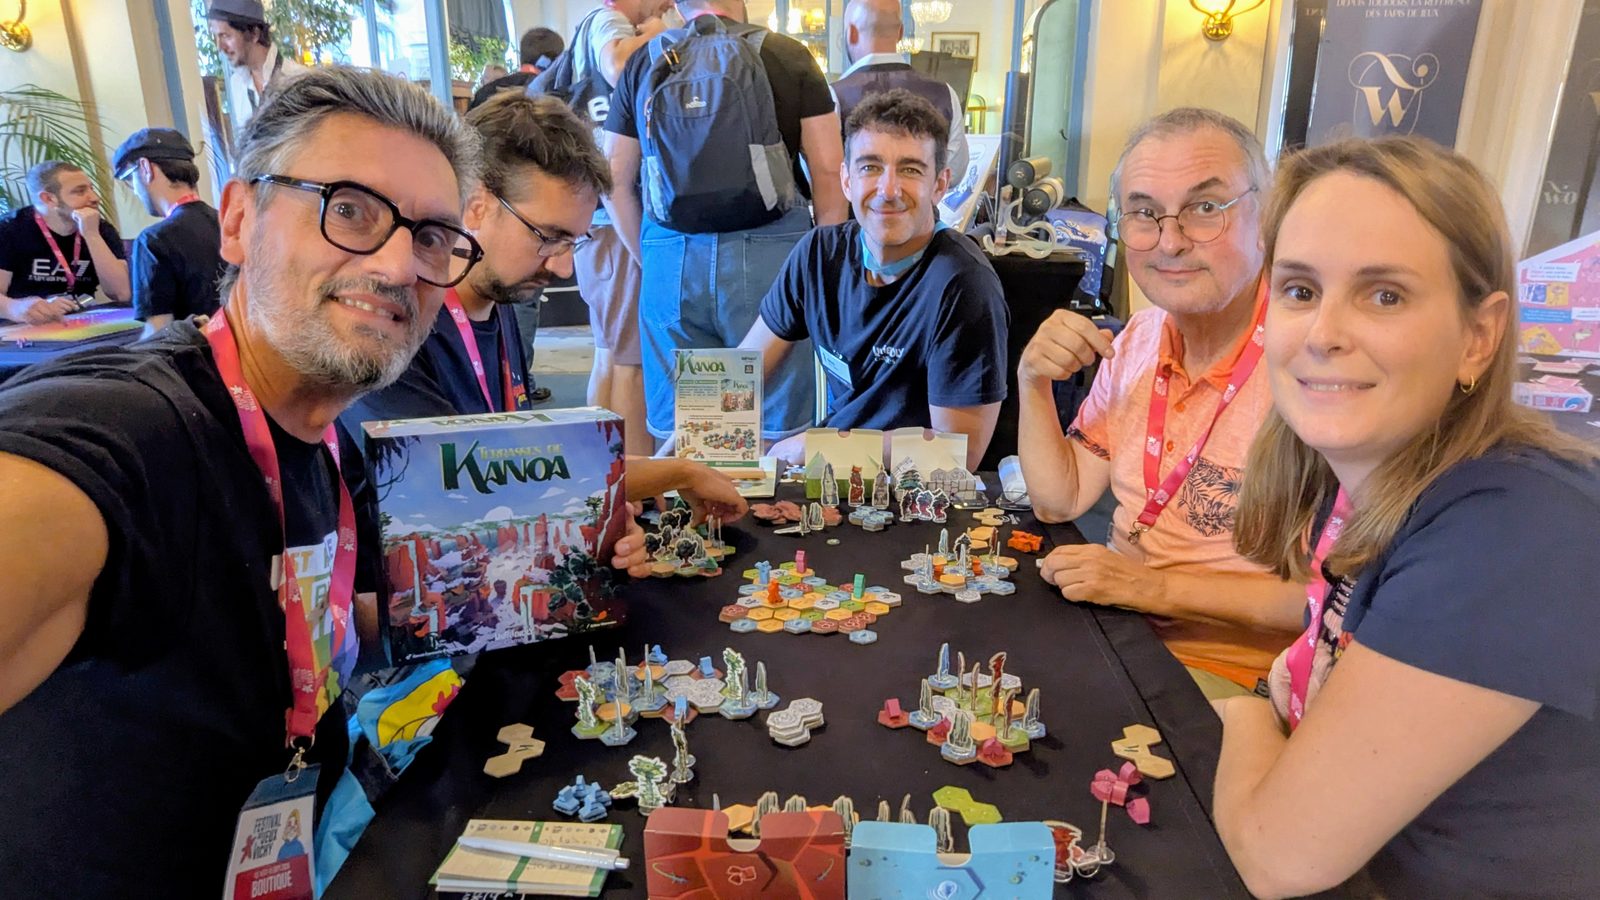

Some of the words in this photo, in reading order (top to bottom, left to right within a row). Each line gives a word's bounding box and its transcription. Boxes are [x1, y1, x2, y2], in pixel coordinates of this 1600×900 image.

[1365, 9, 1380, 17] DES
[1384, 9, 1404, 17] TAPIS
[1407, 9, 1419, 17] DE
[1420, 9, 1439, 17] JEUX
[678, 351, 726, 375] KANOA
[440, 439, 571, 494] KANOA
[254, 813, 282, 834] FESTIVAL
[253, 843, 273, 860] VICHY
[251, 870, 292, 898] BOUTIQUE
